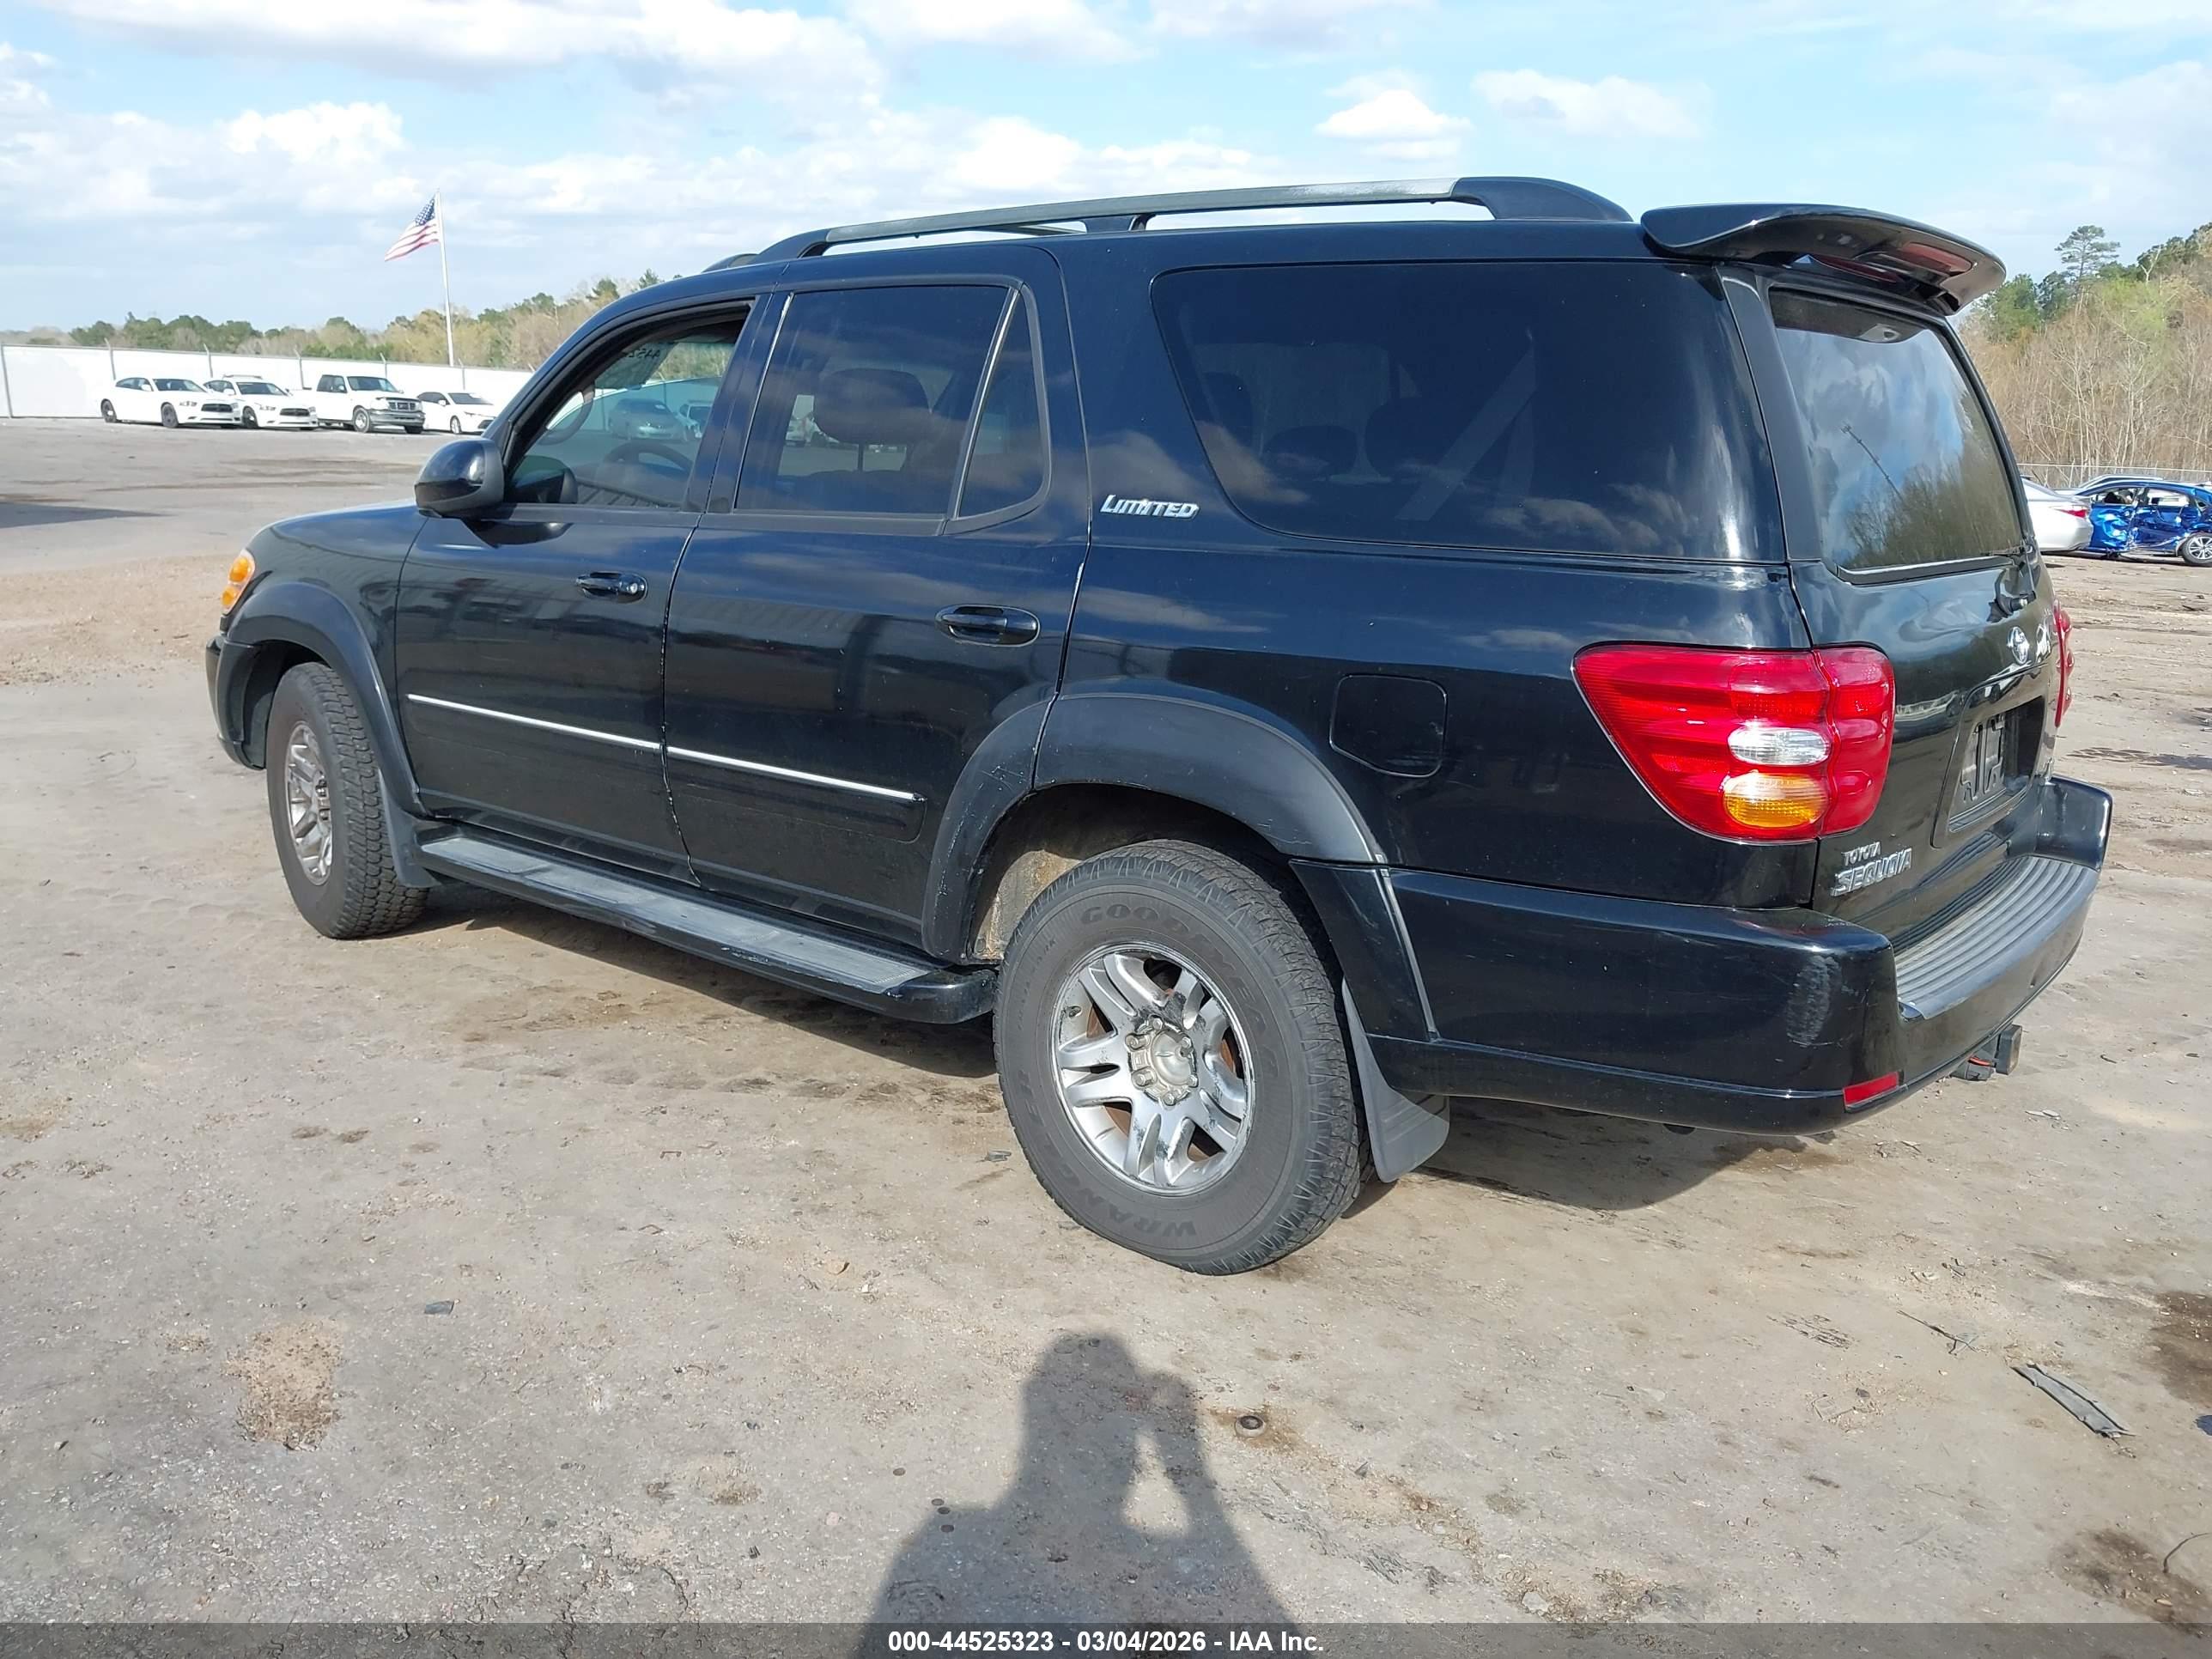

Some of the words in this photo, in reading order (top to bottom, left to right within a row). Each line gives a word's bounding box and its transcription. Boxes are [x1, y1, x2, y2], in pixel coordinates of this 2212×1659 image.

[1100, 494, 1200, 519] LIMITED
[1841, 842, 1881, 866] TOYOTA
[1830, 848, 1912, 896] SEQUOIA
